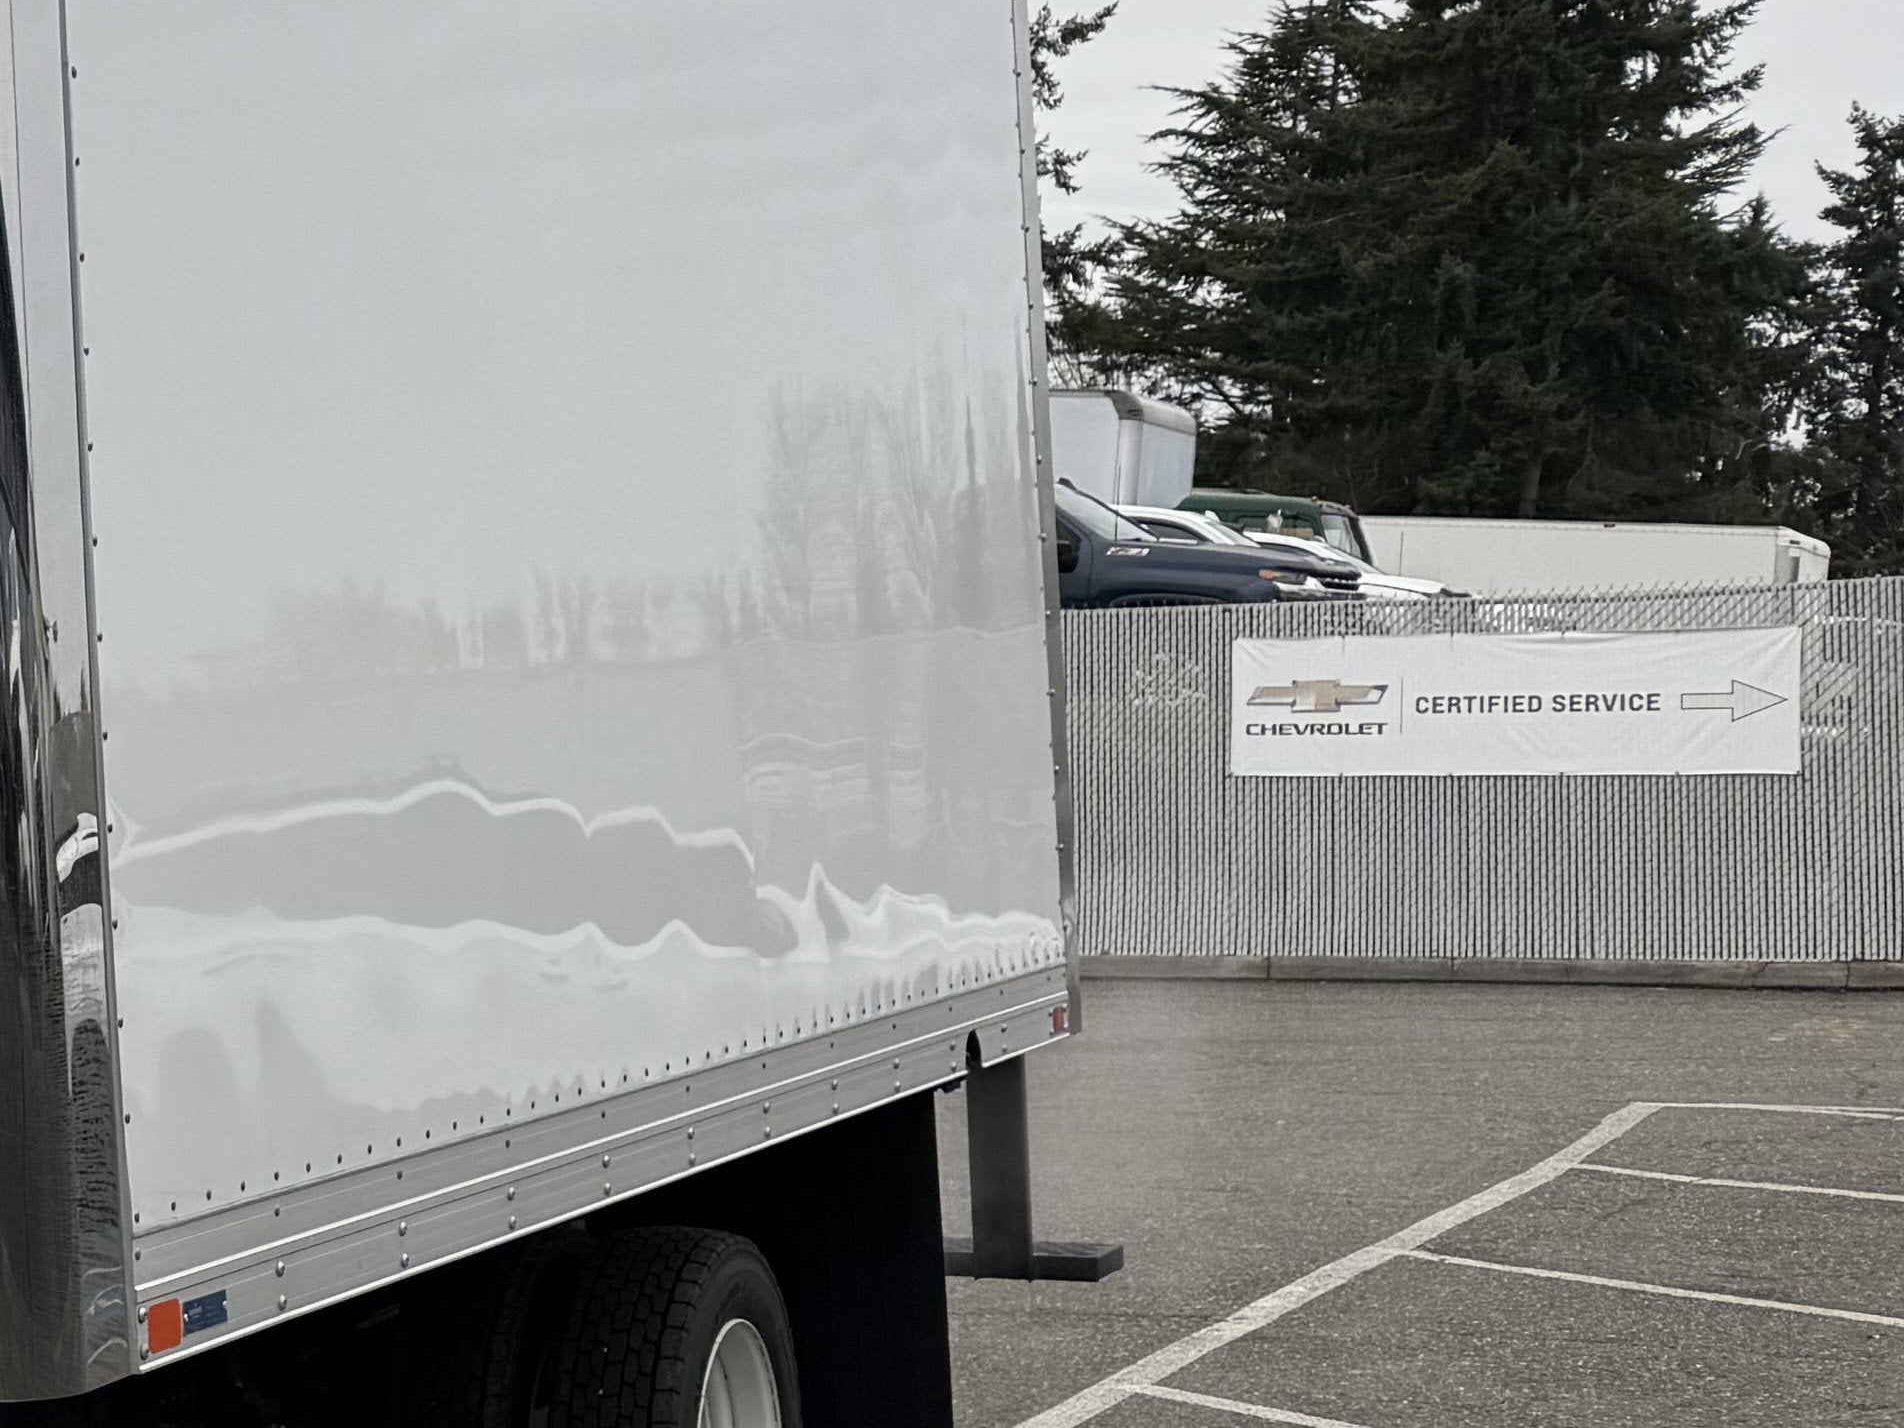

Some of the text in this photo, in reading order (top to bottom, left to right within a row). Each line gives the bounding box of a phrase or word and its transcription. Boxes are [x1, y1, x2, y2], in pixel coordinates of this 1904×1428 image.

[1414, 692, 1662, 714] CERTIFIED SERVICE
[1245, 722, 1388, 736] CHEVROLET
